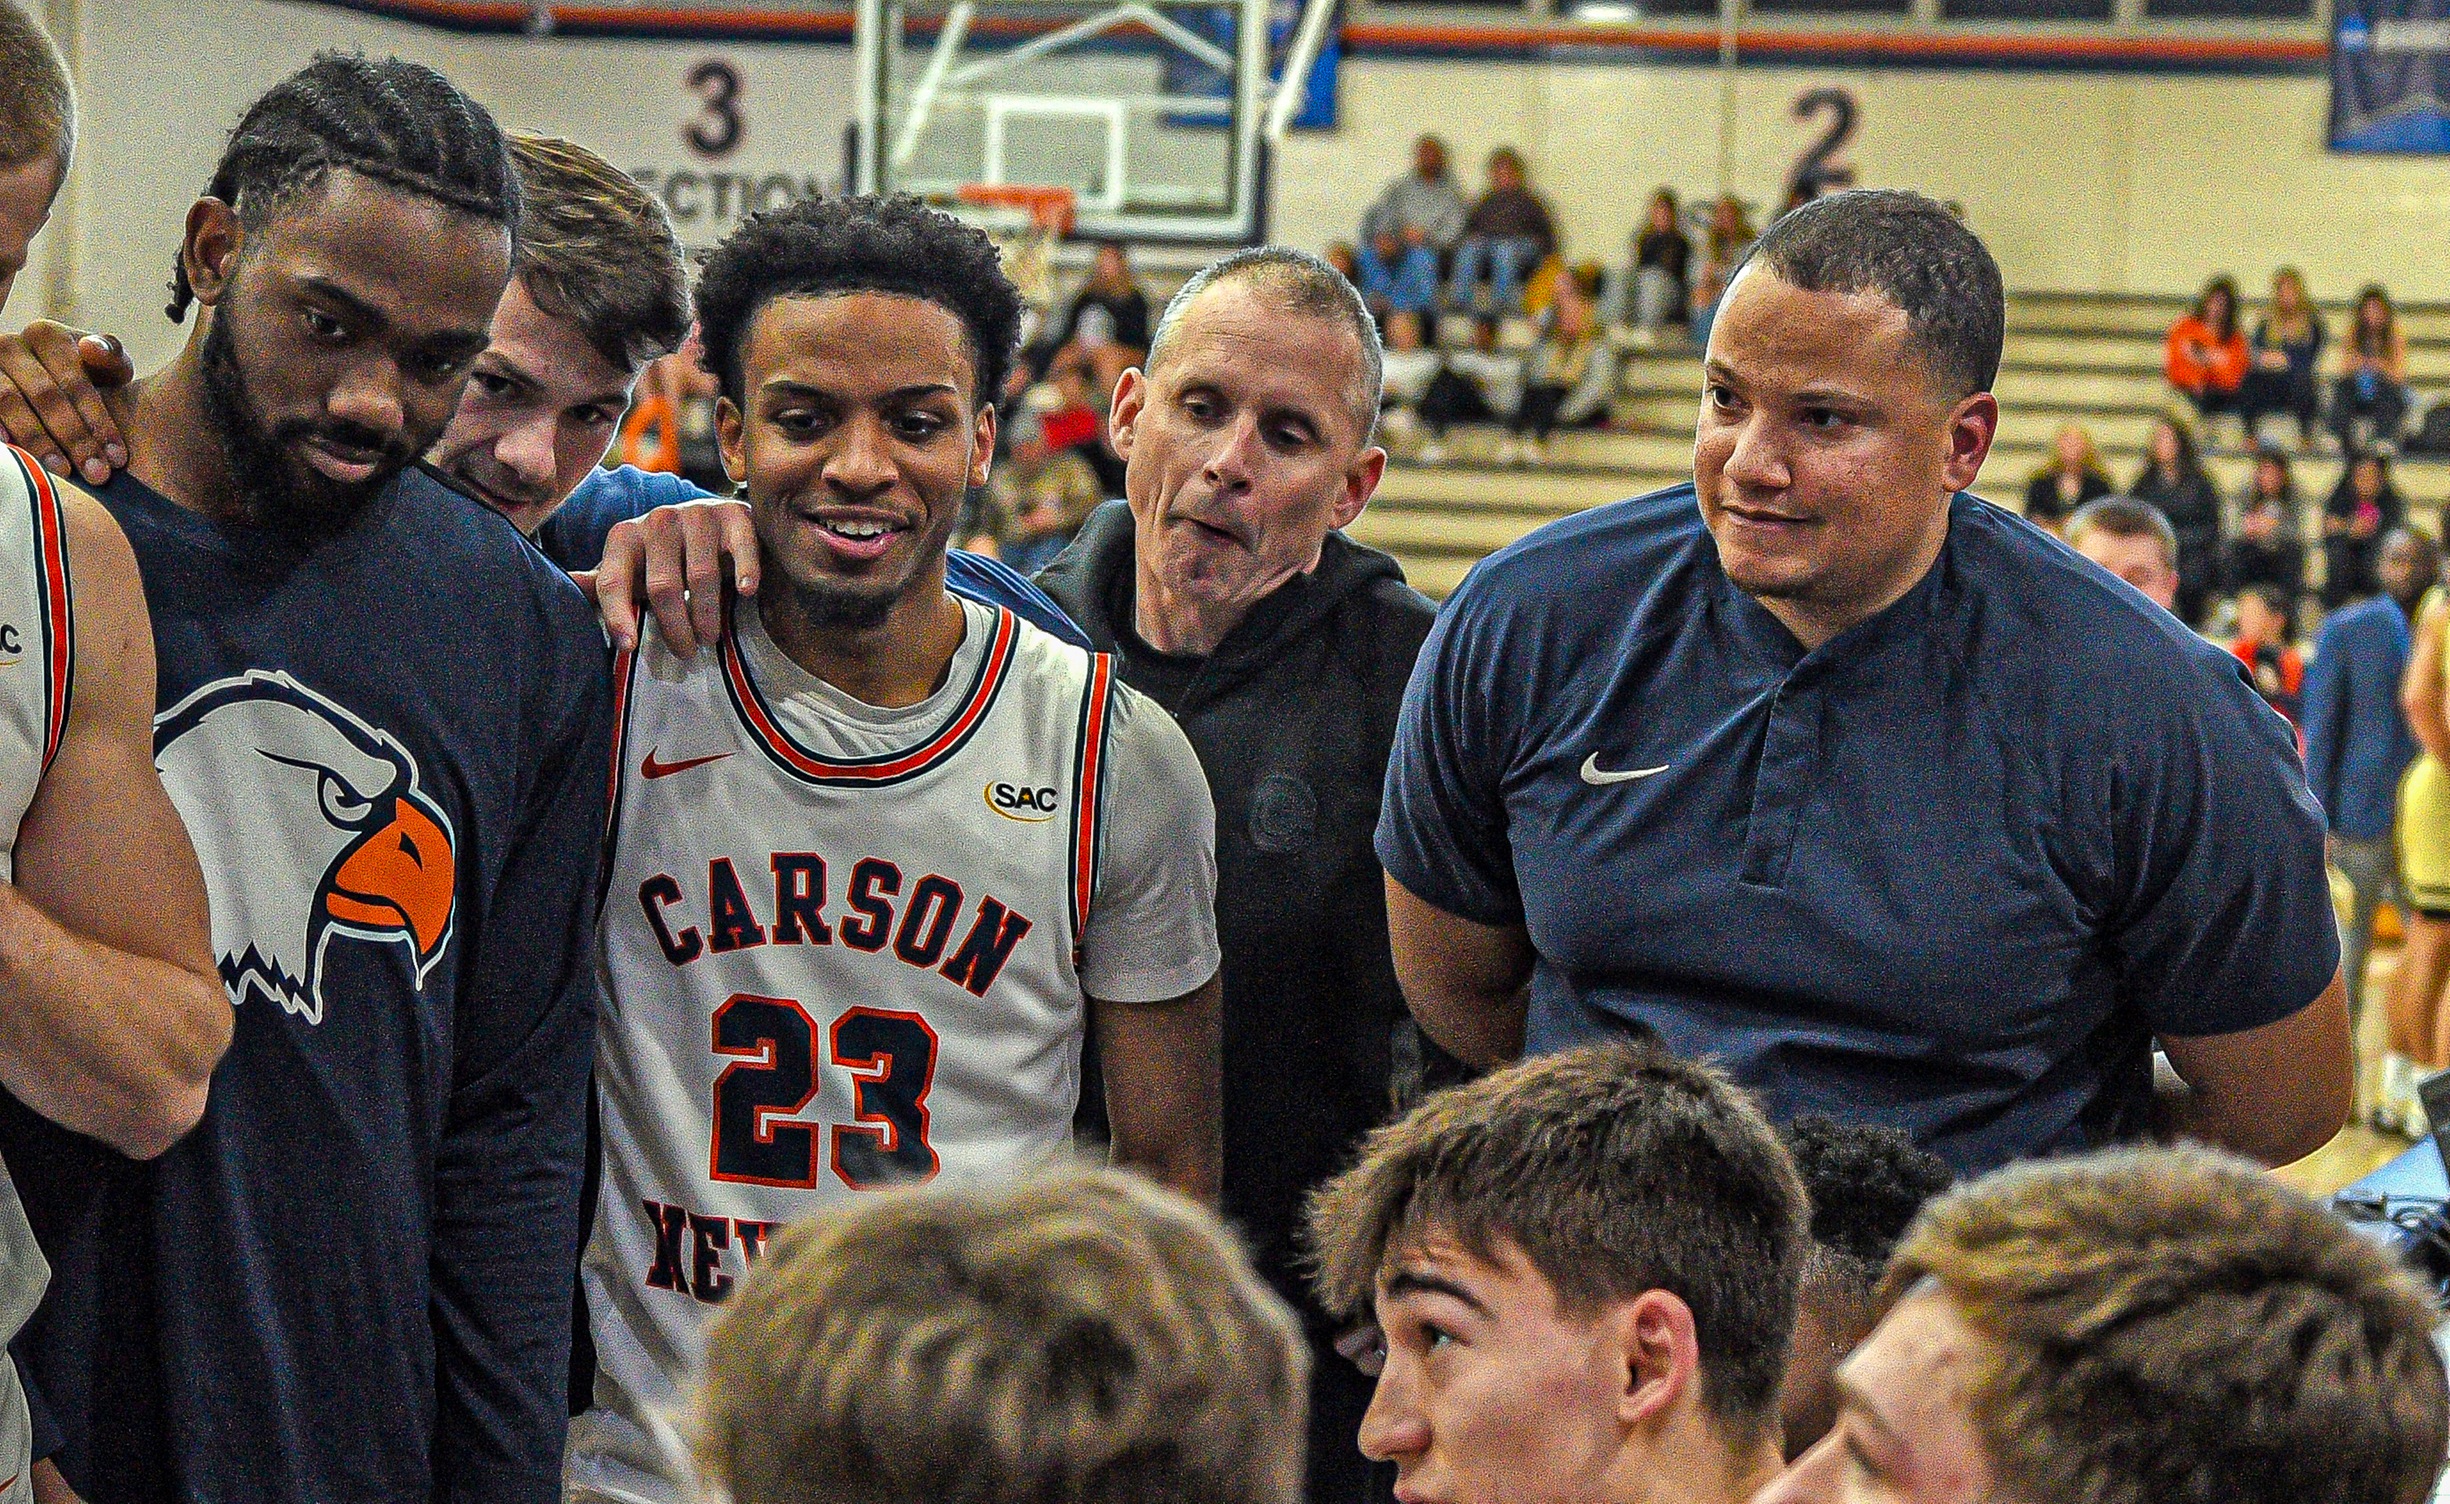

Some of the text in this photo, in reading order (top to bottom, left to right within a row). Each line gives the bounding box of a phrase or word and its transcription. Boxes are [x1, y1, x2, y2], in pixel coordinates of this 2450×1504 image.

[688, 59, 742, 156] 3
[1792, 86, 1858, 190] 2
[629, 169, 840, 222] CTIO
[994, 783, 1058, 812] SAC
[638, 851, 1032, 998] CARSON
[709, 993, 941, 1190] 23
